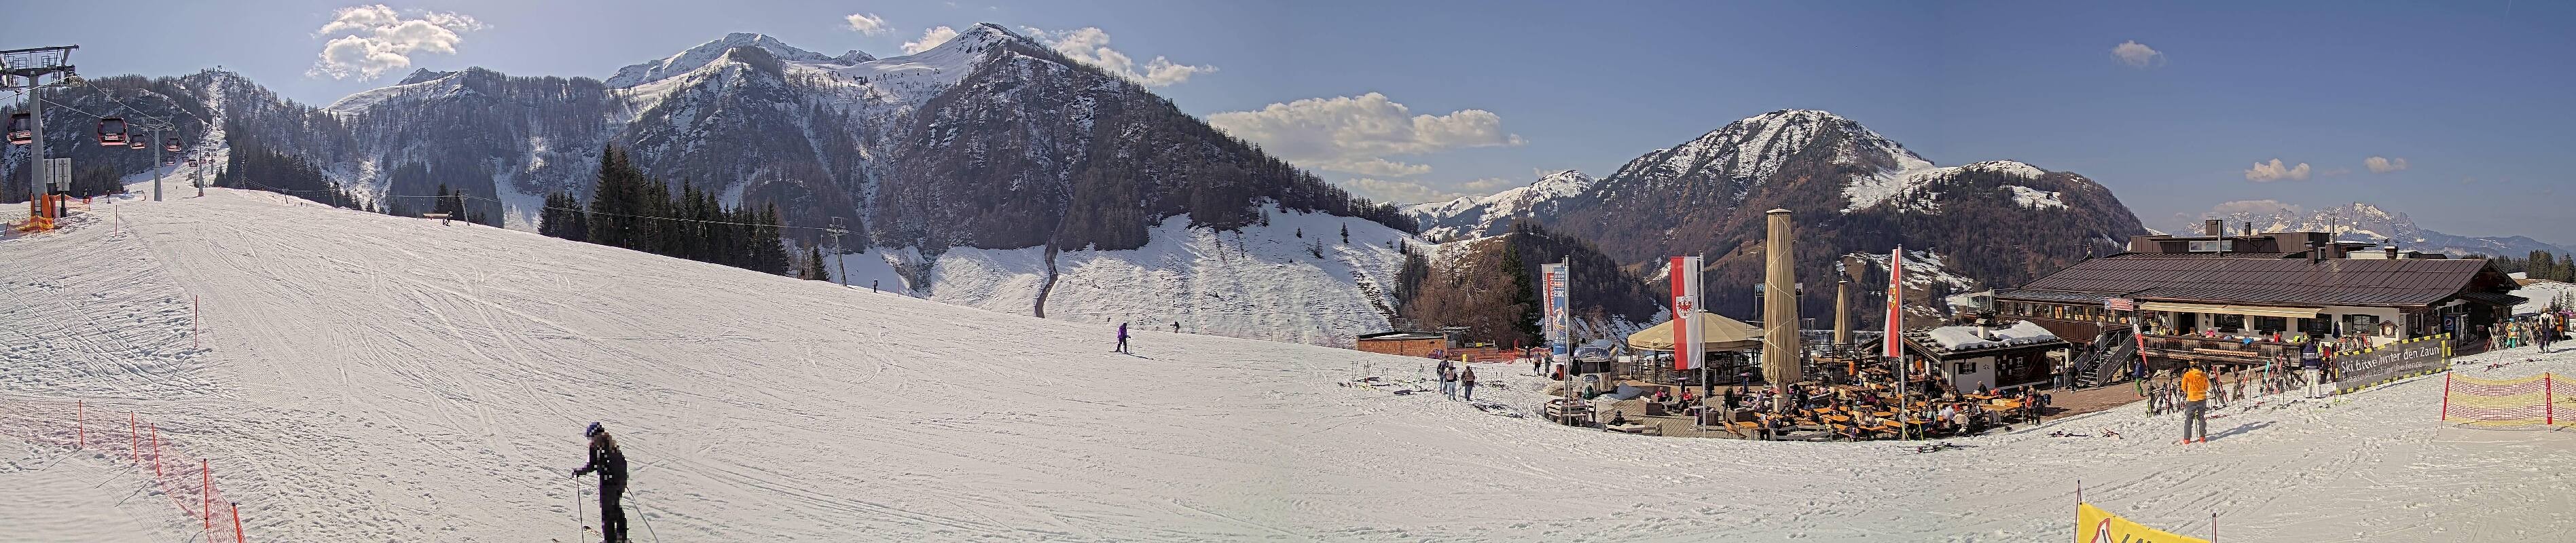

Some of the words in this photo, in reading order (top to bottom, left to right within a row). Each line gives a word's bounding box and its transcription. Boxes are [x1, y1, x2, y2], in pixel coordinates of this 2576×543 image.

[2341, 360, 2354, 373] Ski
[2378, 352, 2401, 366] hinter
[2403, 348, 2418, 360] den
[2420, 346, 2439, 357] Zaun
[2373, 364, 2394, 377] behind
[2406, 360, 2423, 370] fence
